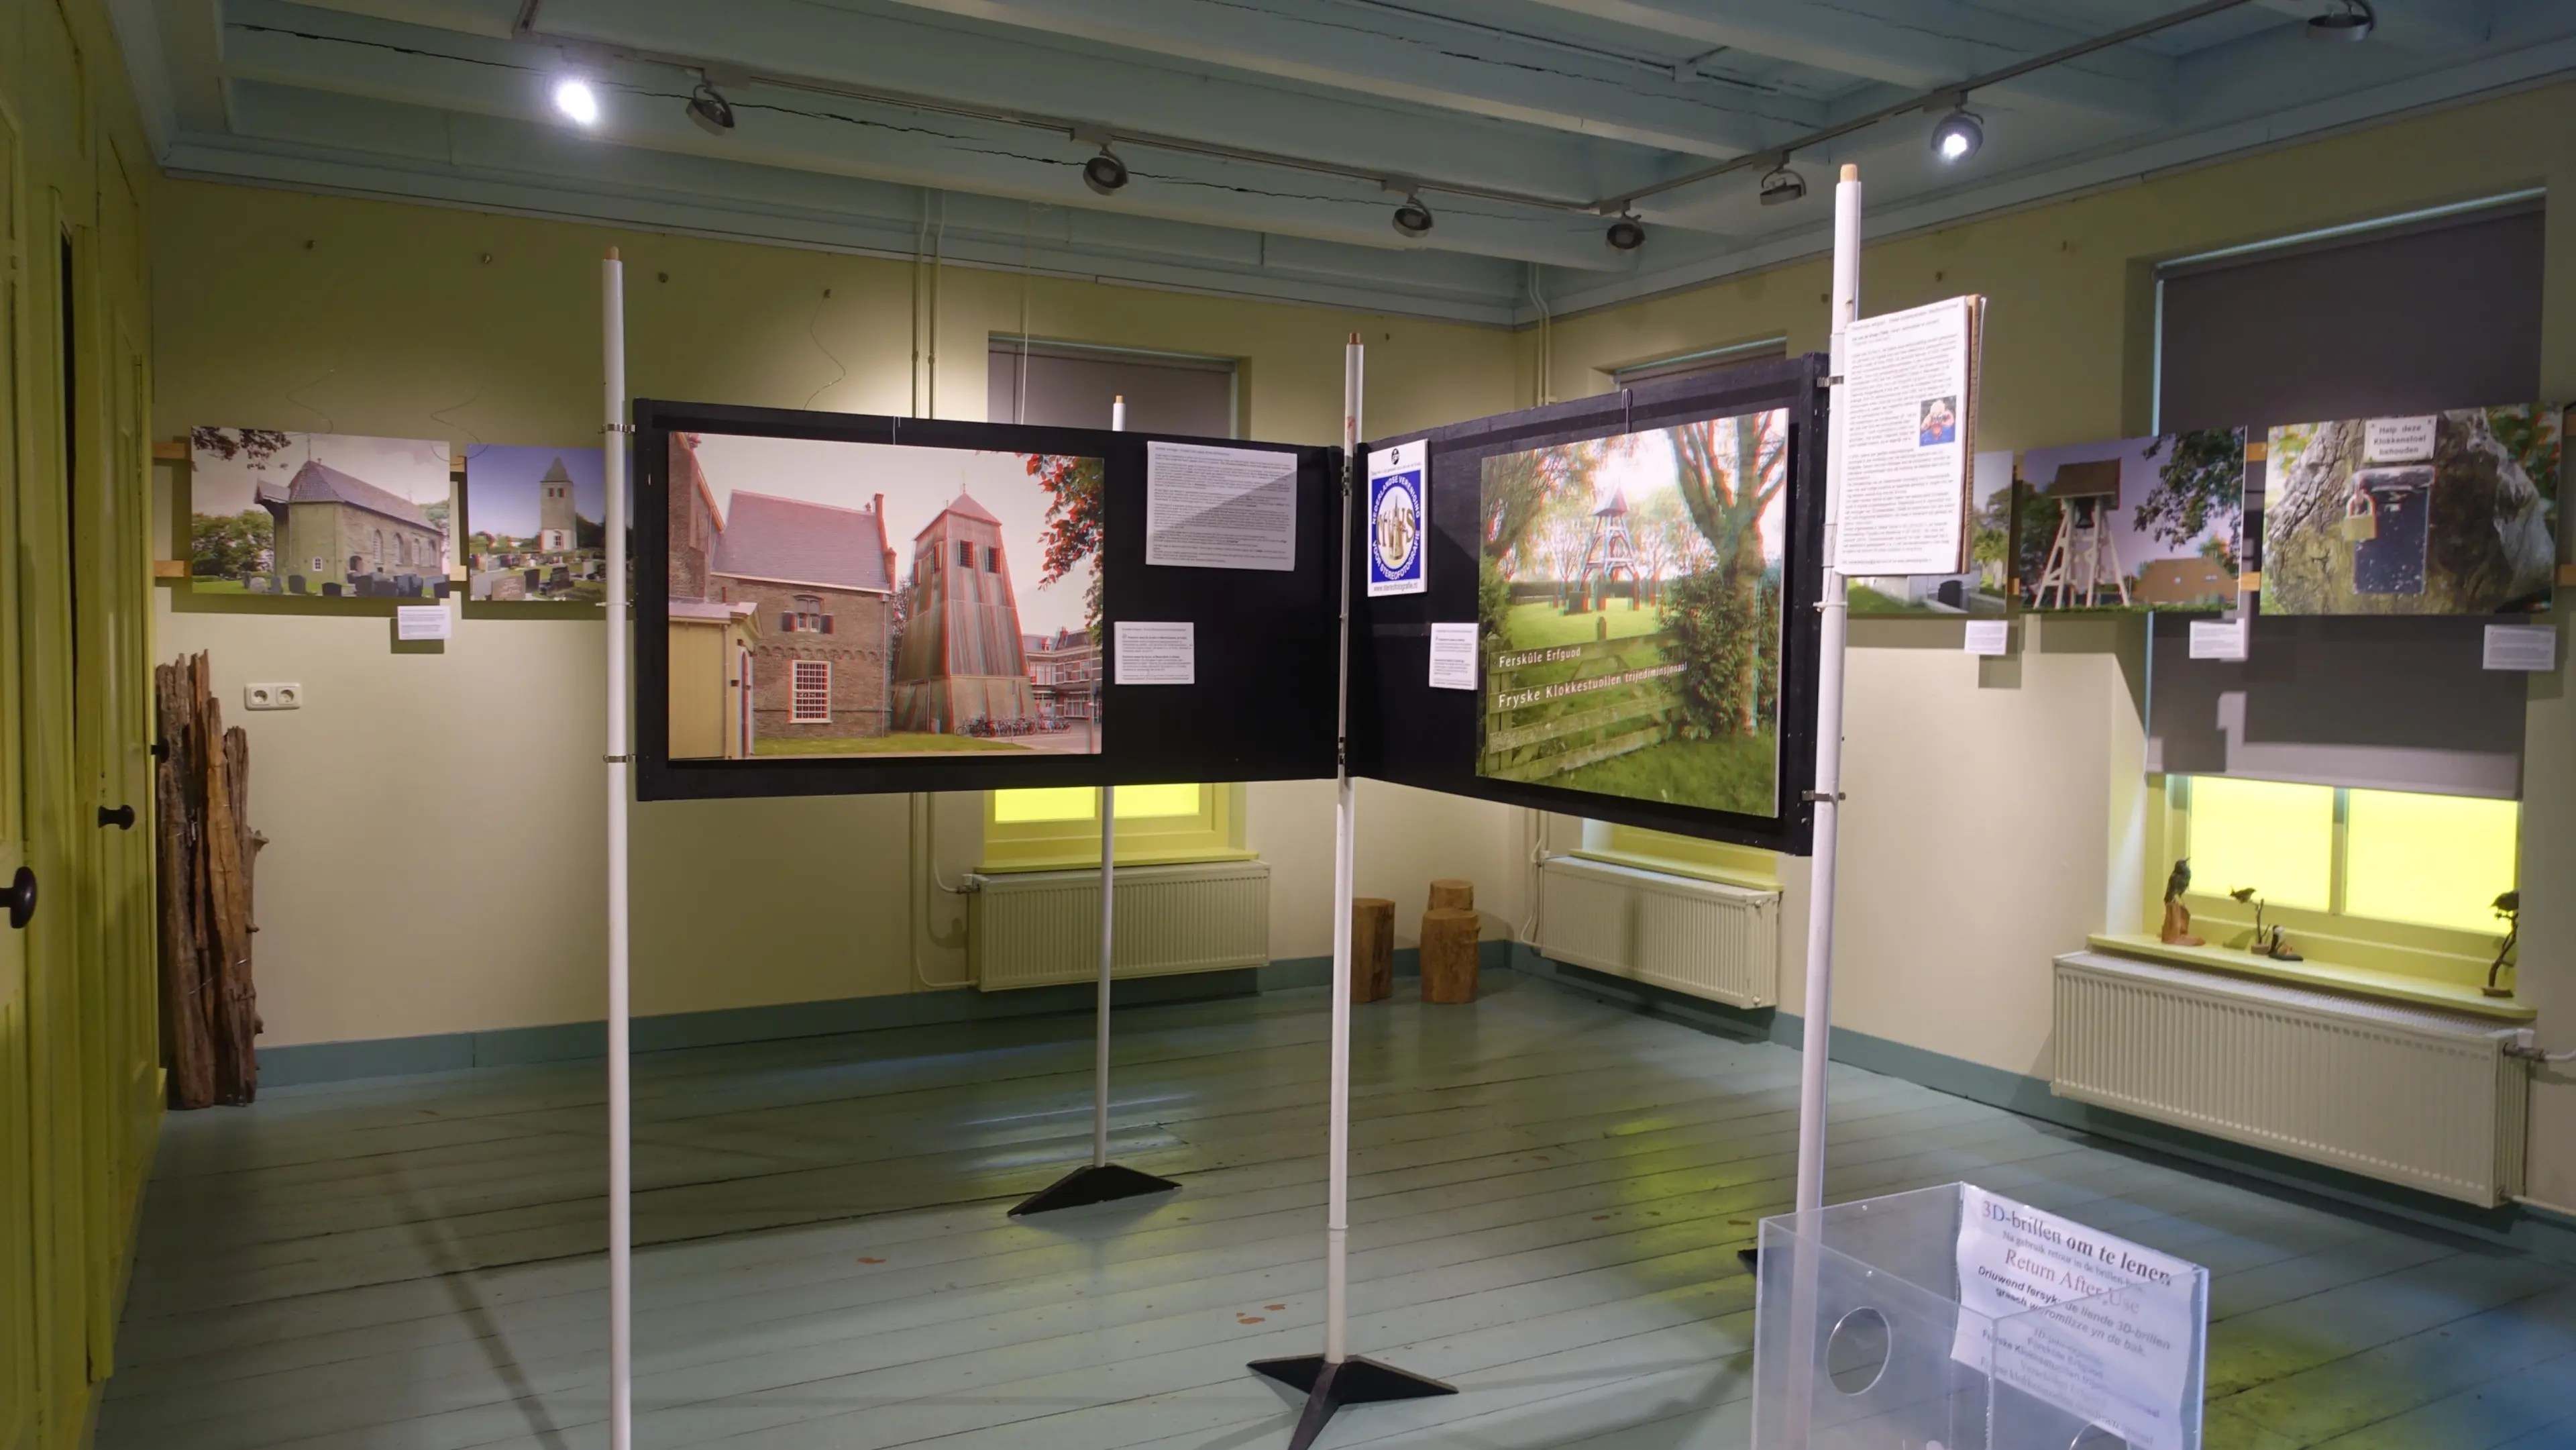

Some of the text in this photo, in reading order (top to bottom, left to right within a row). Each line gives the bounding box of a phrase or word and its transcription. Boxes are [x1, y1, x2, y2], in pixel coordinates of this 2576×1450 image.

[2379, 426, 2398, 435] Help
[1373, 475, 1420, 525] NEDERLANDSE VERENIGING
[1373, 540, 1381, 567] VOOR
[1499, 647, 1581, 668] Ferskûle Erfguod
[1499, 690, 1540, 709] Fryske
[1546, 674, 1621, 698] Klokkestuollen
[1982, 1200, 2171, 1287] 3D-brillen om te lenen
[2002, 1230, 2014, 1242] Na
[2016, 1236, 2045, 1254] gebruik
[2047, 1249, 2072, 1264] retour
[2074, 1259, 2082, 1267] in
[2084, 1262, 2094, 1273] de
[2004, 1247, 2140, 1314] Return After Use
[1978, 1265, 2025, 1292] Driuwend
[2116, 1319, 2171, 1351] 3D-brillen
[2030, 1302, 2089, 1333] wromlizze
[2090, 1327, 2105, 1341] yn
[2108, 1333, 2121, 1346] de
